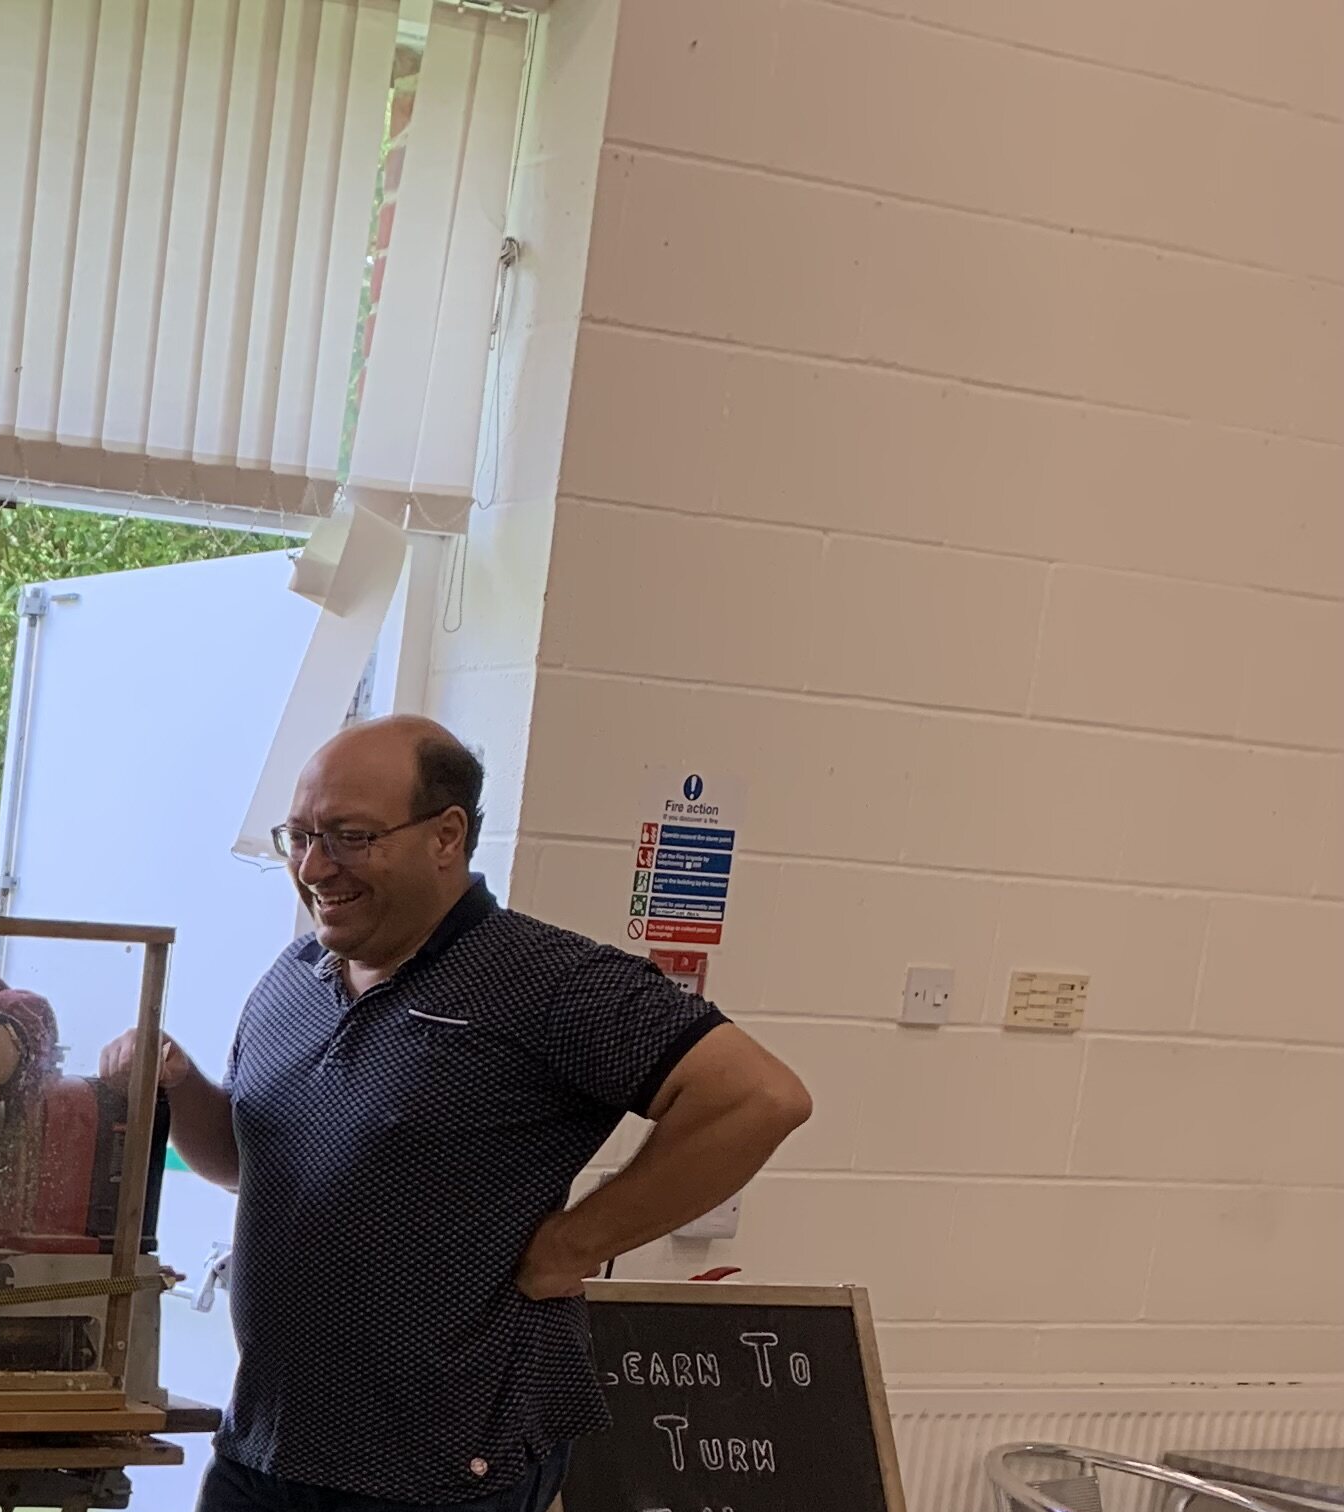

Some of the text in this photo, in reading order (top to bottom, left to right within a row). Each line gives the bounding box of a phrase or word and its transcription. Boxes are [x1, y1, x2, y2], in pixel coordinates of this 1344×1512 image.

[665, 800, 719, 816] Fire action
[608, 1351, 721, 1387] EARN
[653, 1415, 776, 1473] TURN
